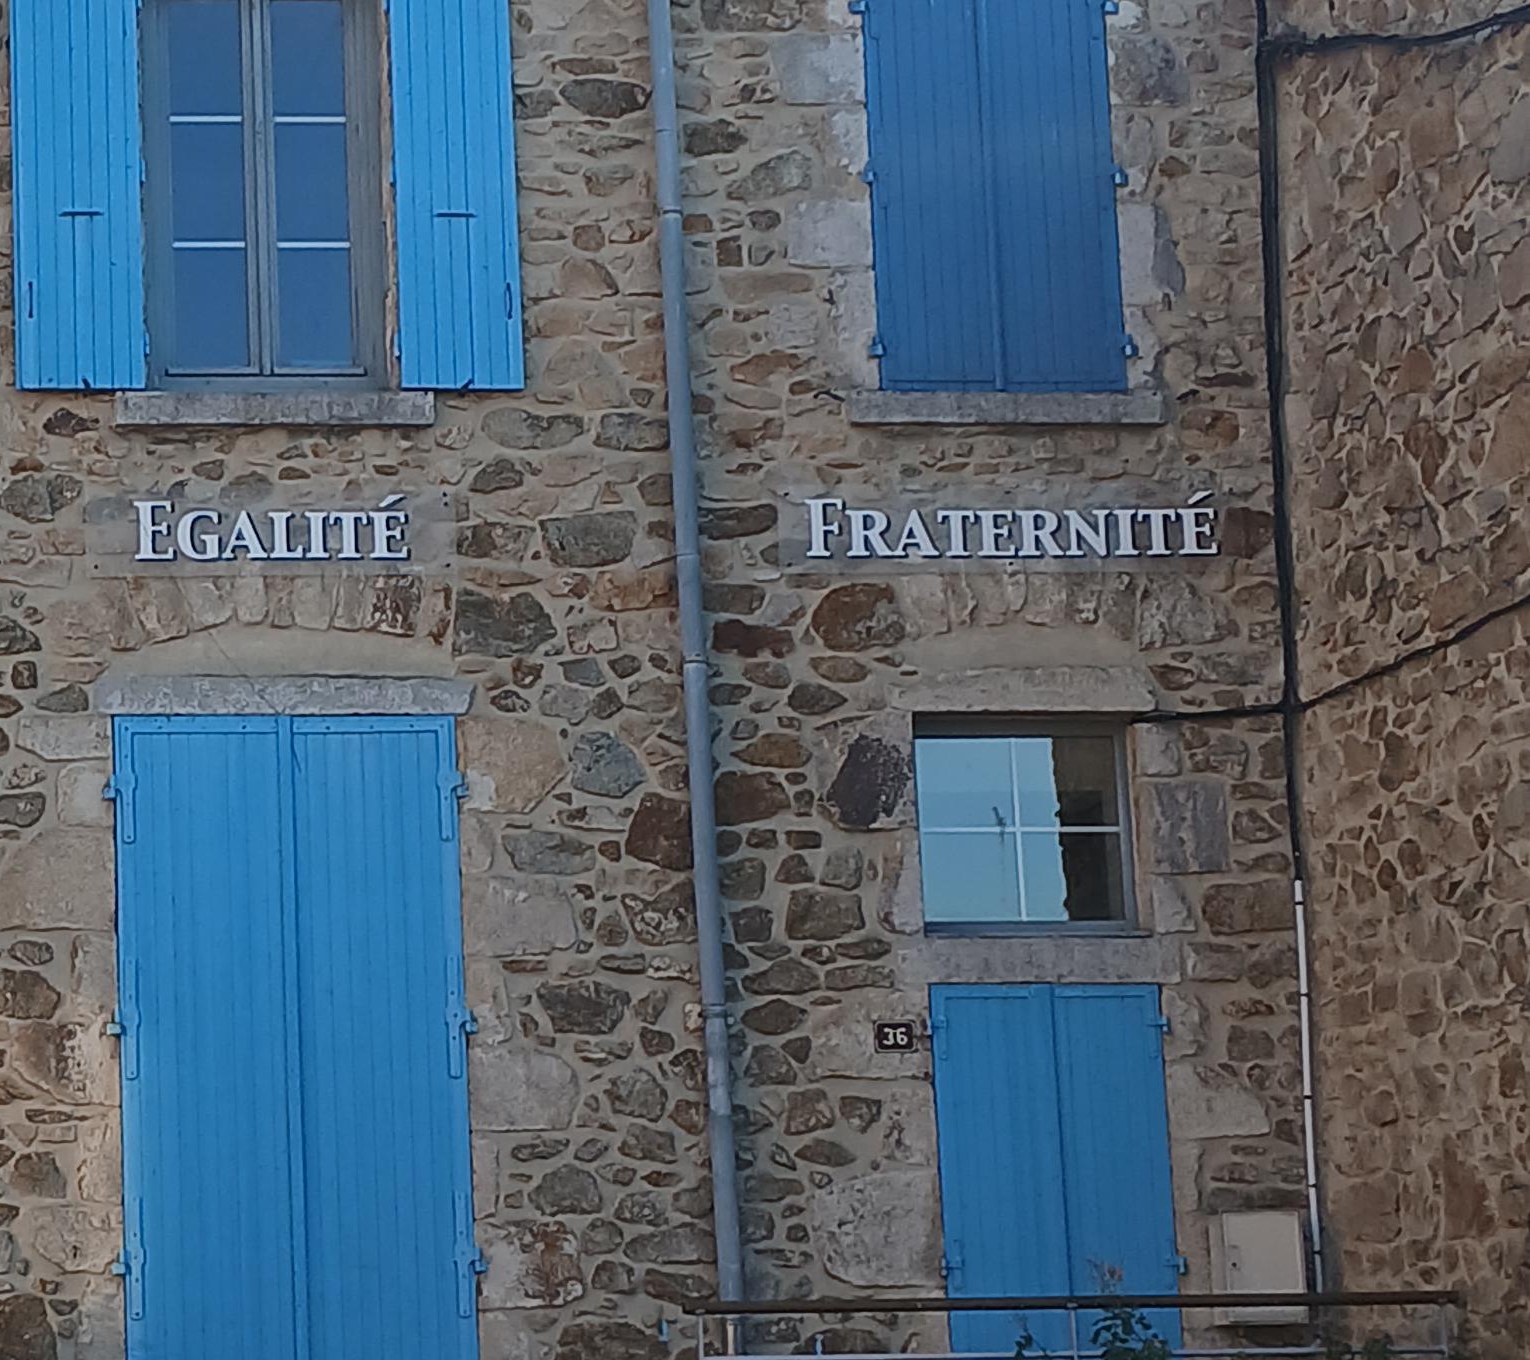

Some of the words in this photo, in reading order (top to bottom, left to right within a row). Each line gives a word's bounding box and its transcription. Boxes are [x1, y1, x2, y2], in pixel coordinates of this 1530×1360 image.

[133, 494, 411, 561] EGALITÉ
[804, 490, 1220, 558] FRATERNITÉ
[882, 1027, 908, 1045] 36
